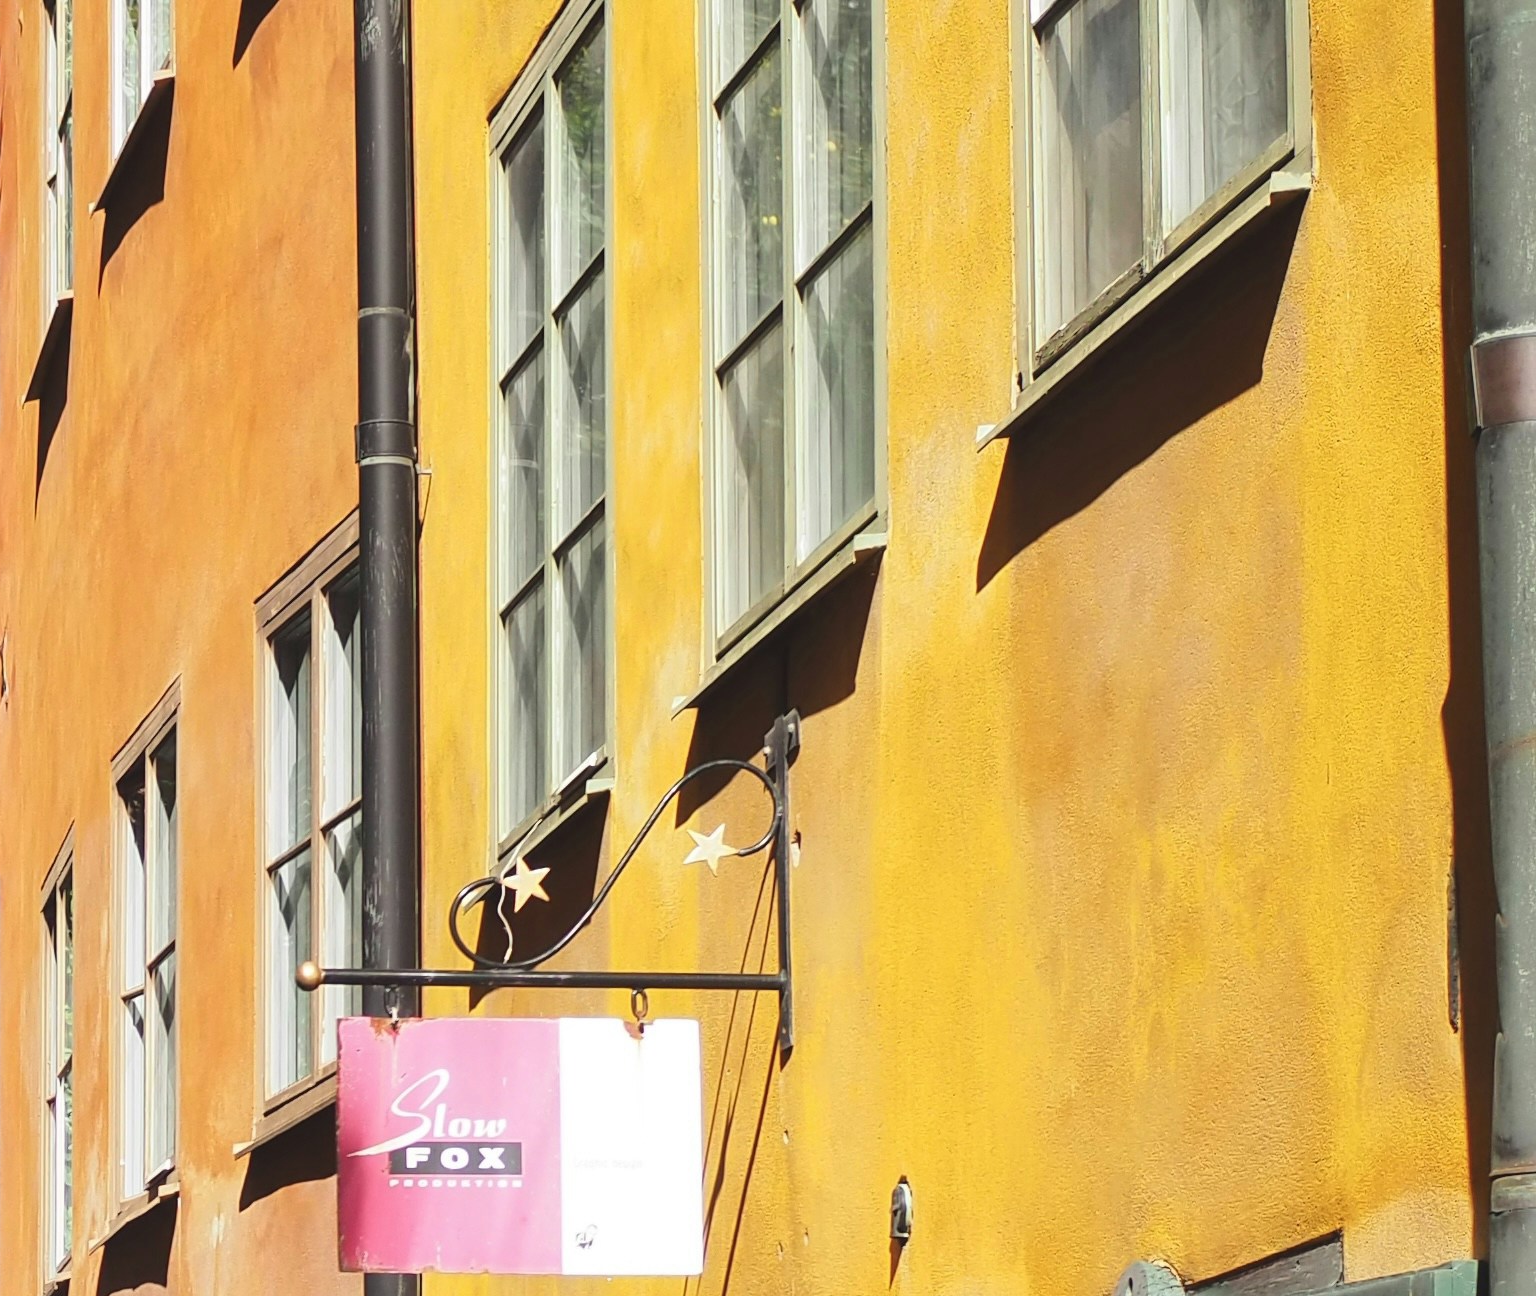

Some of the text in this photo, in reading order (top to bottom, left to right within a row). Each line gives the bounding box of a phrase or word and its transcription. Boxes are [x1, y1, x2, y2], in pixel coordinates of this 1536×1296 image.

[346, 1068, 508, 1158] Slow
[405, 1146, 506, 1170] FOX
[388, 1179, 523, 1188] PRODUKTION
